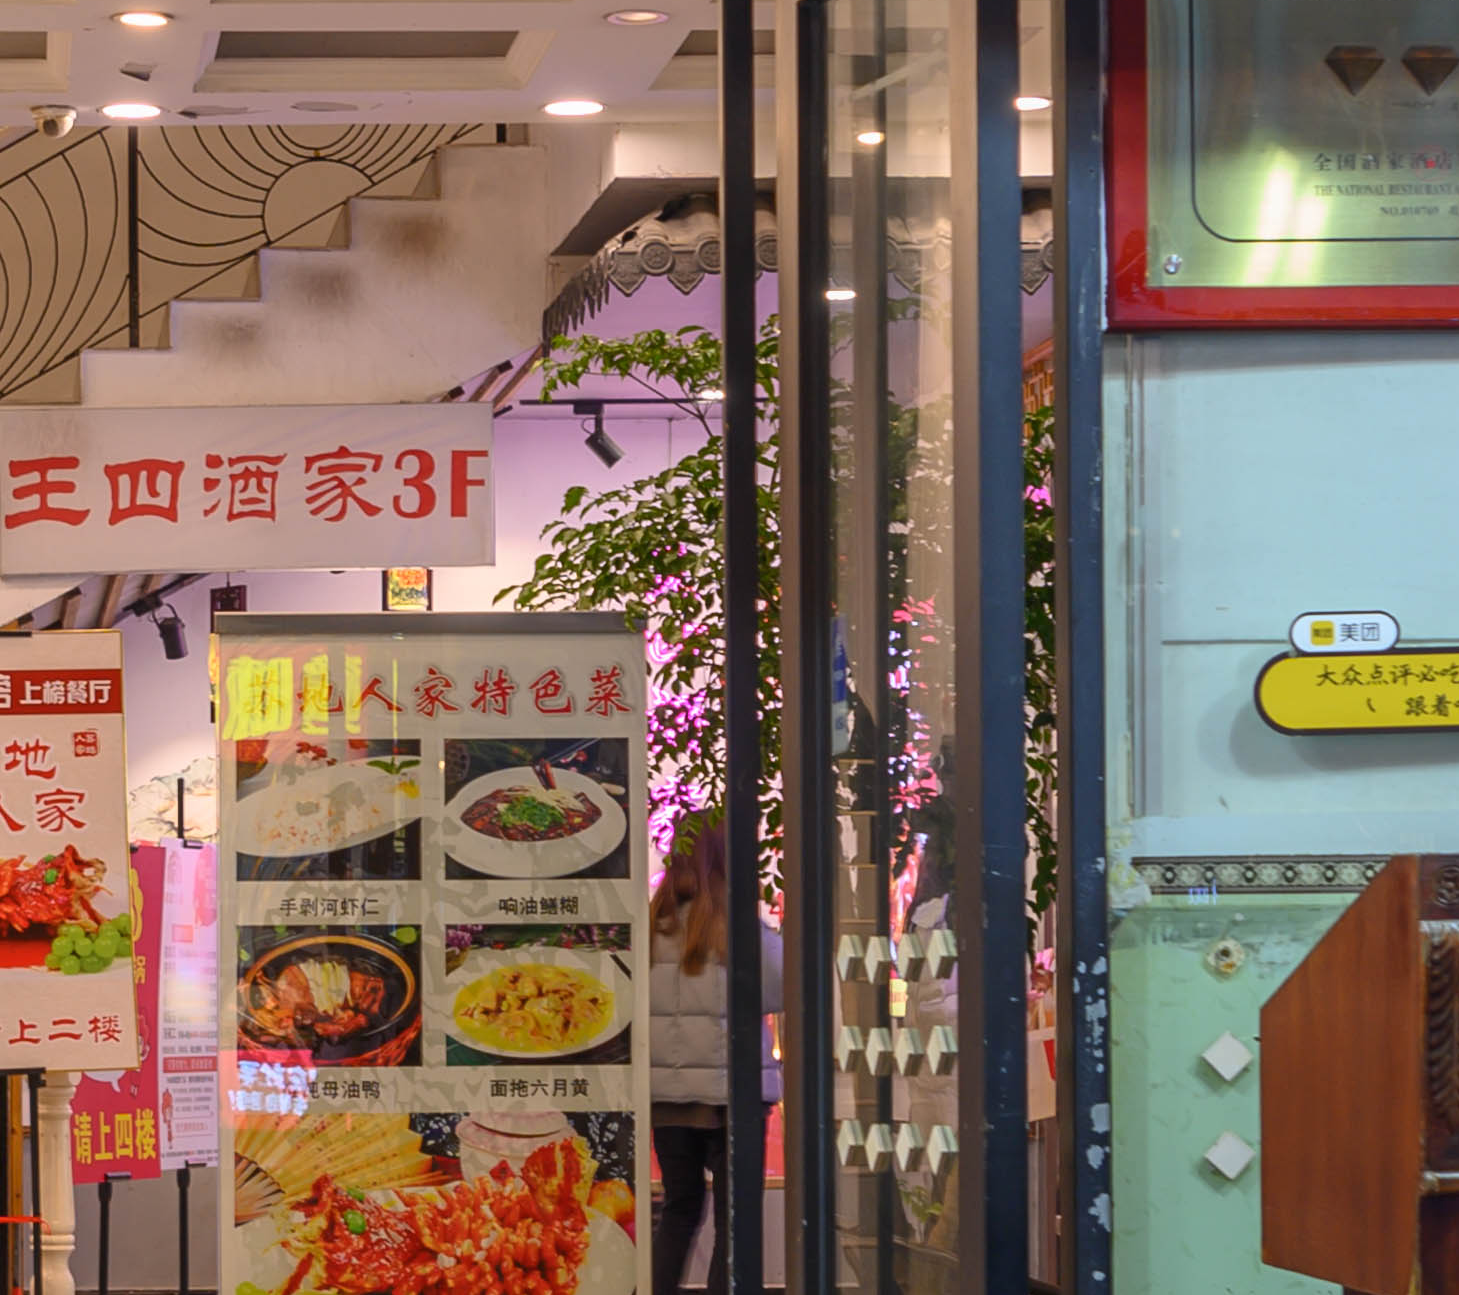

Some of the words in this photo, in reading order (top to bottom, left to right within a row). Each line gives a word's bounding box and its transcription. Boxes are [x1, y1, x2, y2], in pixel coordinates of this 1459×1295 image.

[4, 445, 489, 530] 王四酒家3F
[1340, 622, 1380, 643] 美团
[20, 679, 112, 705] 上榜餐厅
[280, 896, 380, 917] 手剥河虾仁
[499, 896, 579, 917] 响油鳝糊
[491, 1079, 590, 1099] 面拖六月黄
[73, 1107, 157, 1165] 请上四楼
